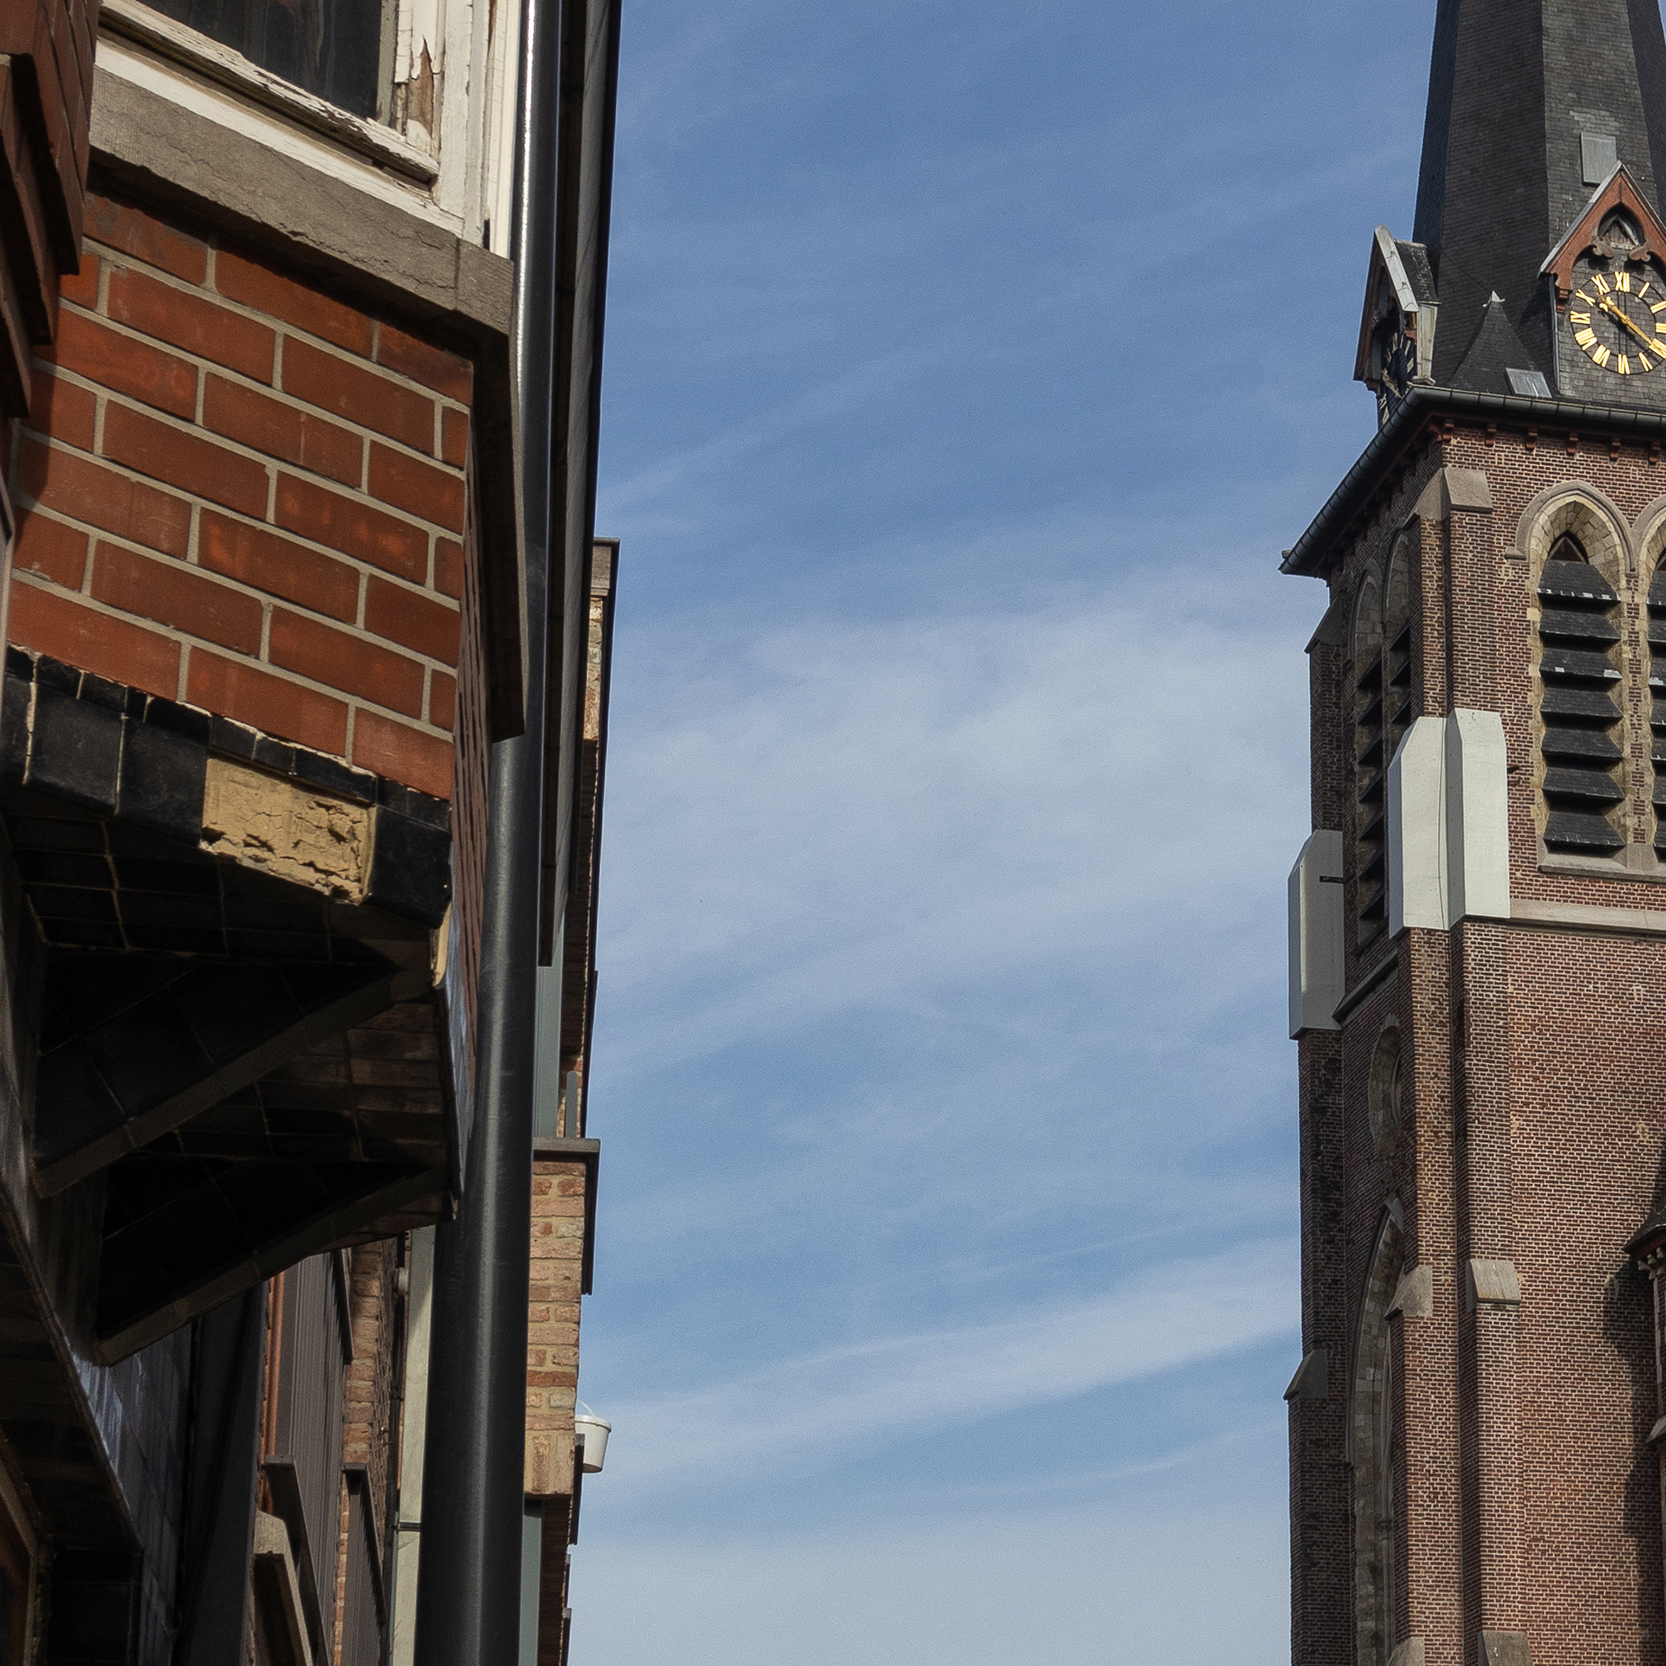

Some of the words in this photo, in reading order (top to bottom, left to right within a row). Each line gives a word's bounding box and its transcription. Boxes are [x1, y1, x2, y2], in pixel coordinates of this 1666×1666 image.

[1591, 273, 1611, 295] XI
[1614, 271, 1630, 292] XII
[1638, 282, 1650, 298] I
[1575, 289, 1596, 307] X
[1570, 310, 1591, 324] IX
[1574, 327, 1598, 351] VIII
[1592, 344, 1611, 367] VII
[1617, 353, 1630, 375] VI
[1638, 352, 1653, 372] V
